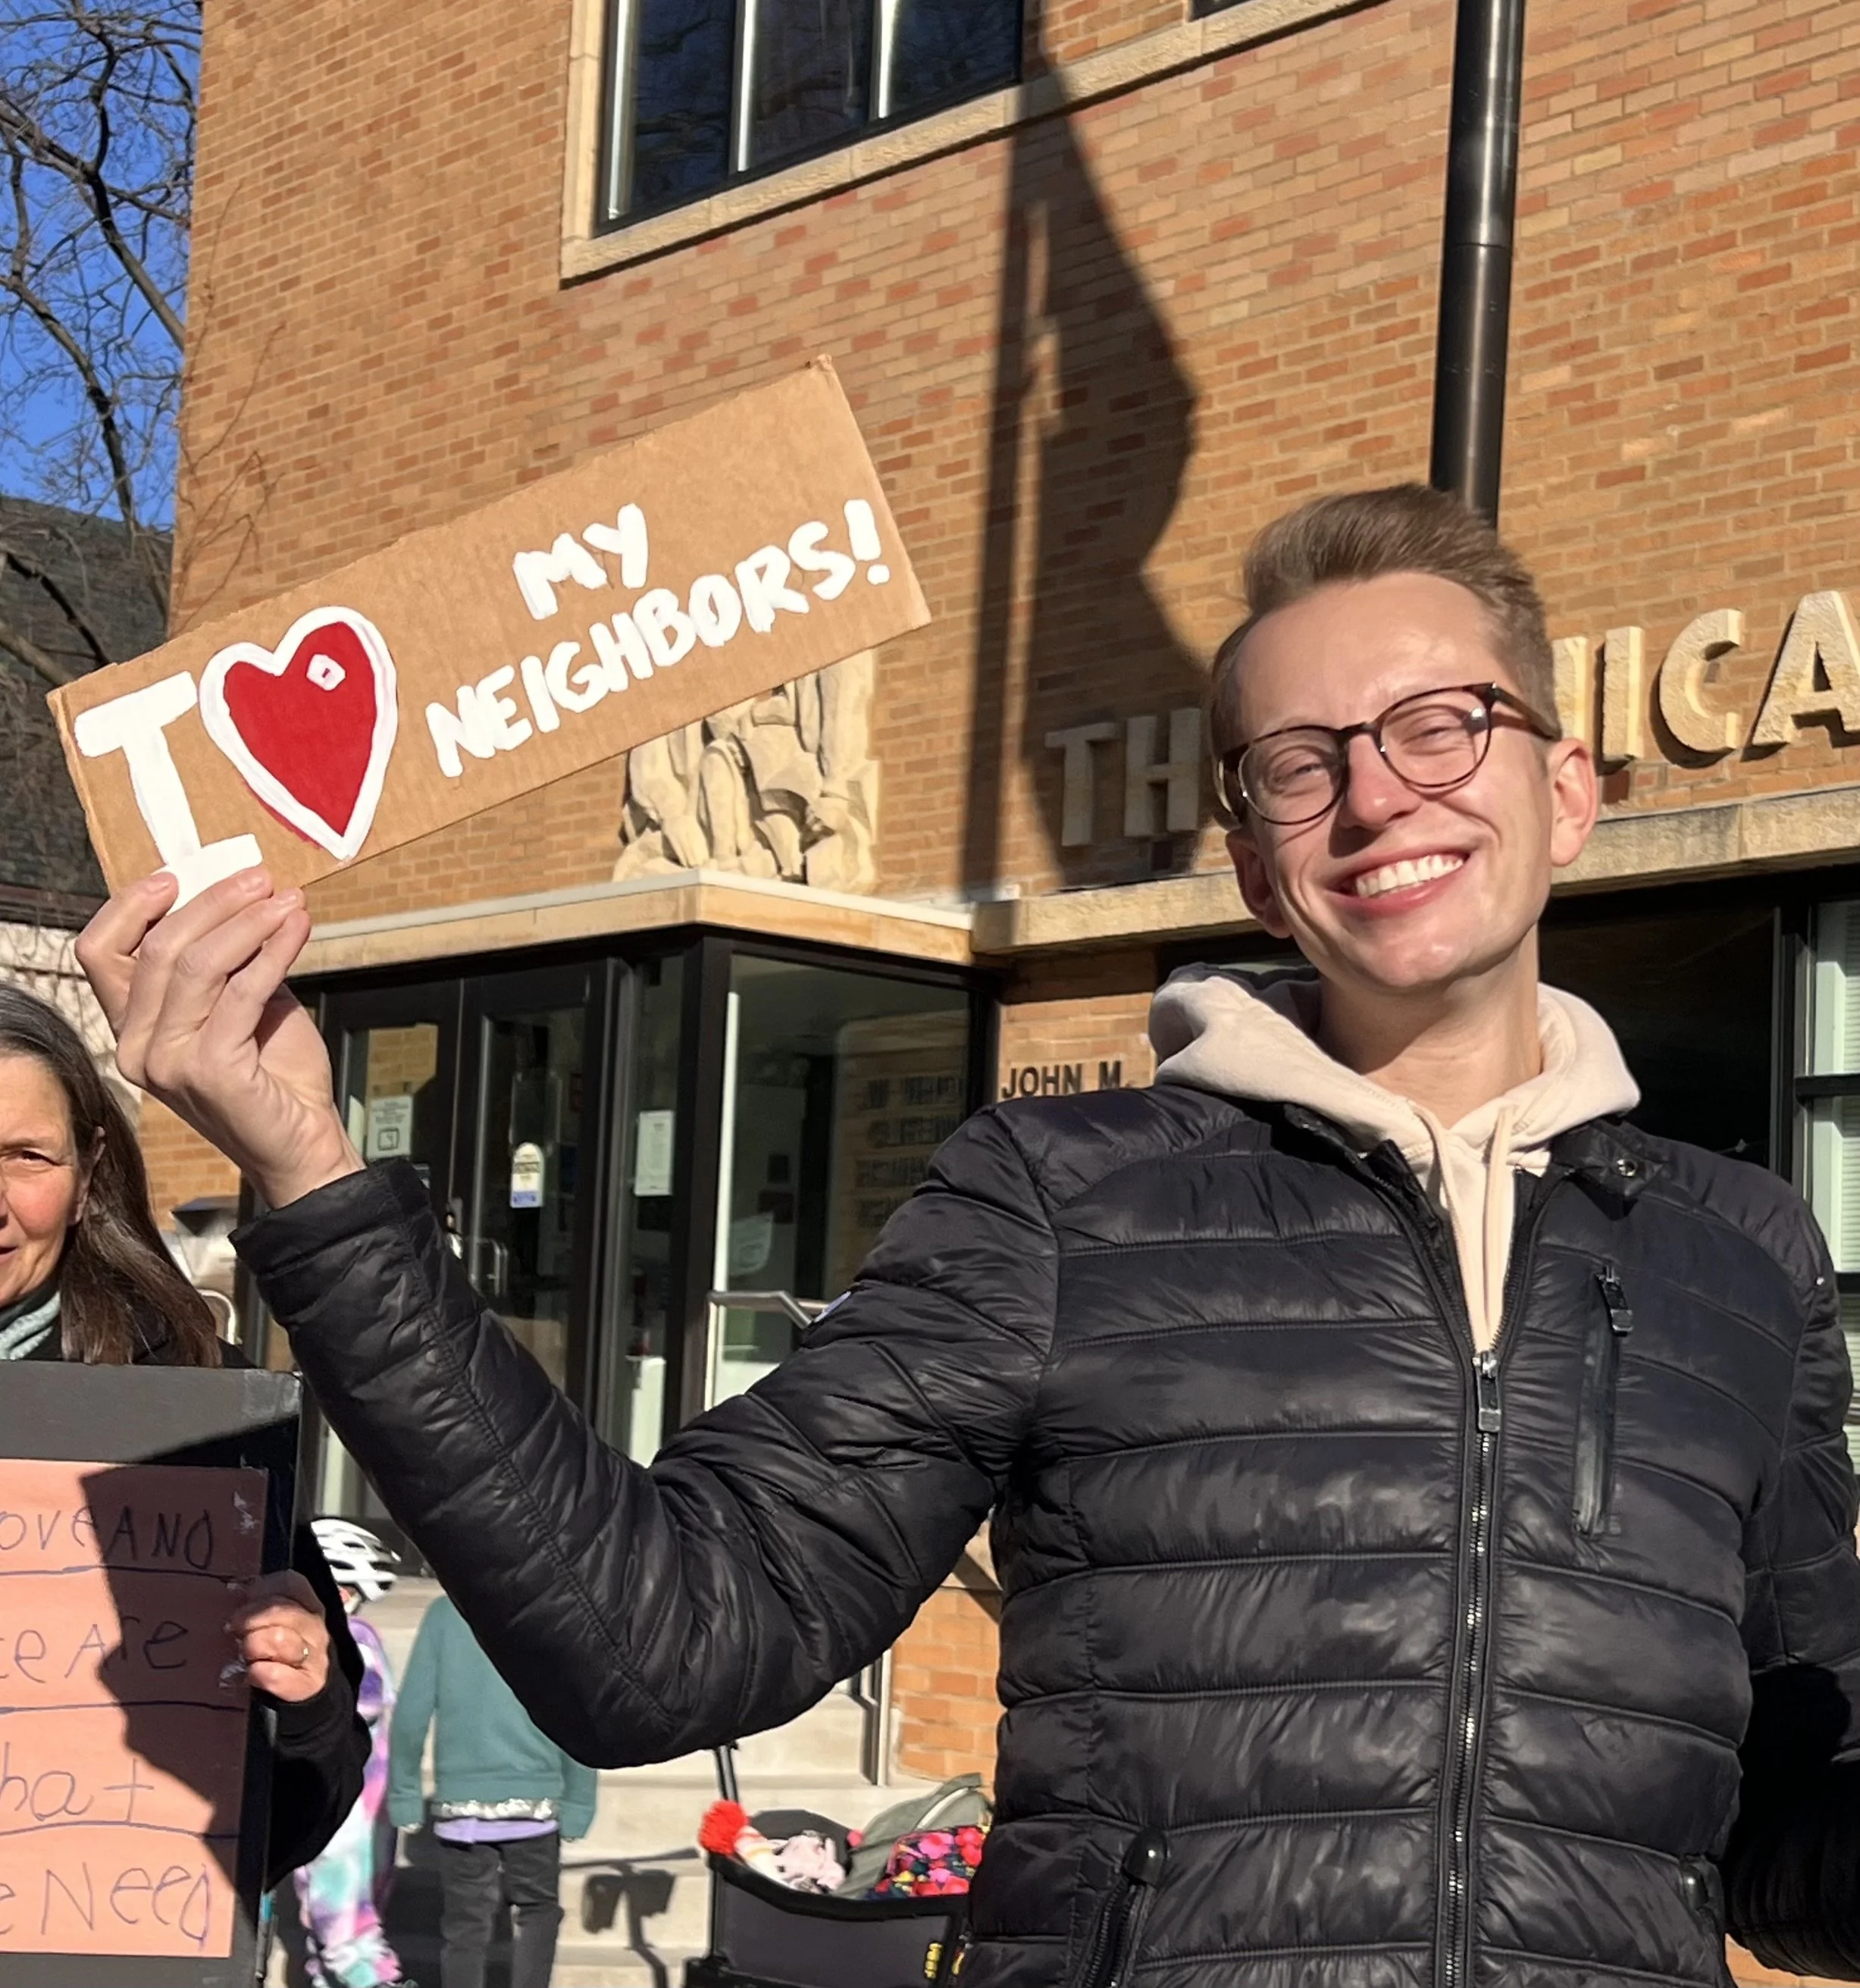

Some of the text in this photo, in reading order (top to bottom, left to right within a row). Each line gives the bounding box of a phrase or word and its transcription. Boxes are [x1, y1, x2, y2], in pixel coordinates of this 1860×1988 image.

[512, 503, 649, 620] MY
[426, 499, 891, 777] NEIGHBORS!
[74, 672, 262, 916] I
[1044, 706, 1202, 847] TH
[1001, 1063, 1082, 1099] JOHN
[64, 1615, 189, 1670] Are
[0, 1741, 155, 1822] hat
[41, 1861, 212, 1949] Need
